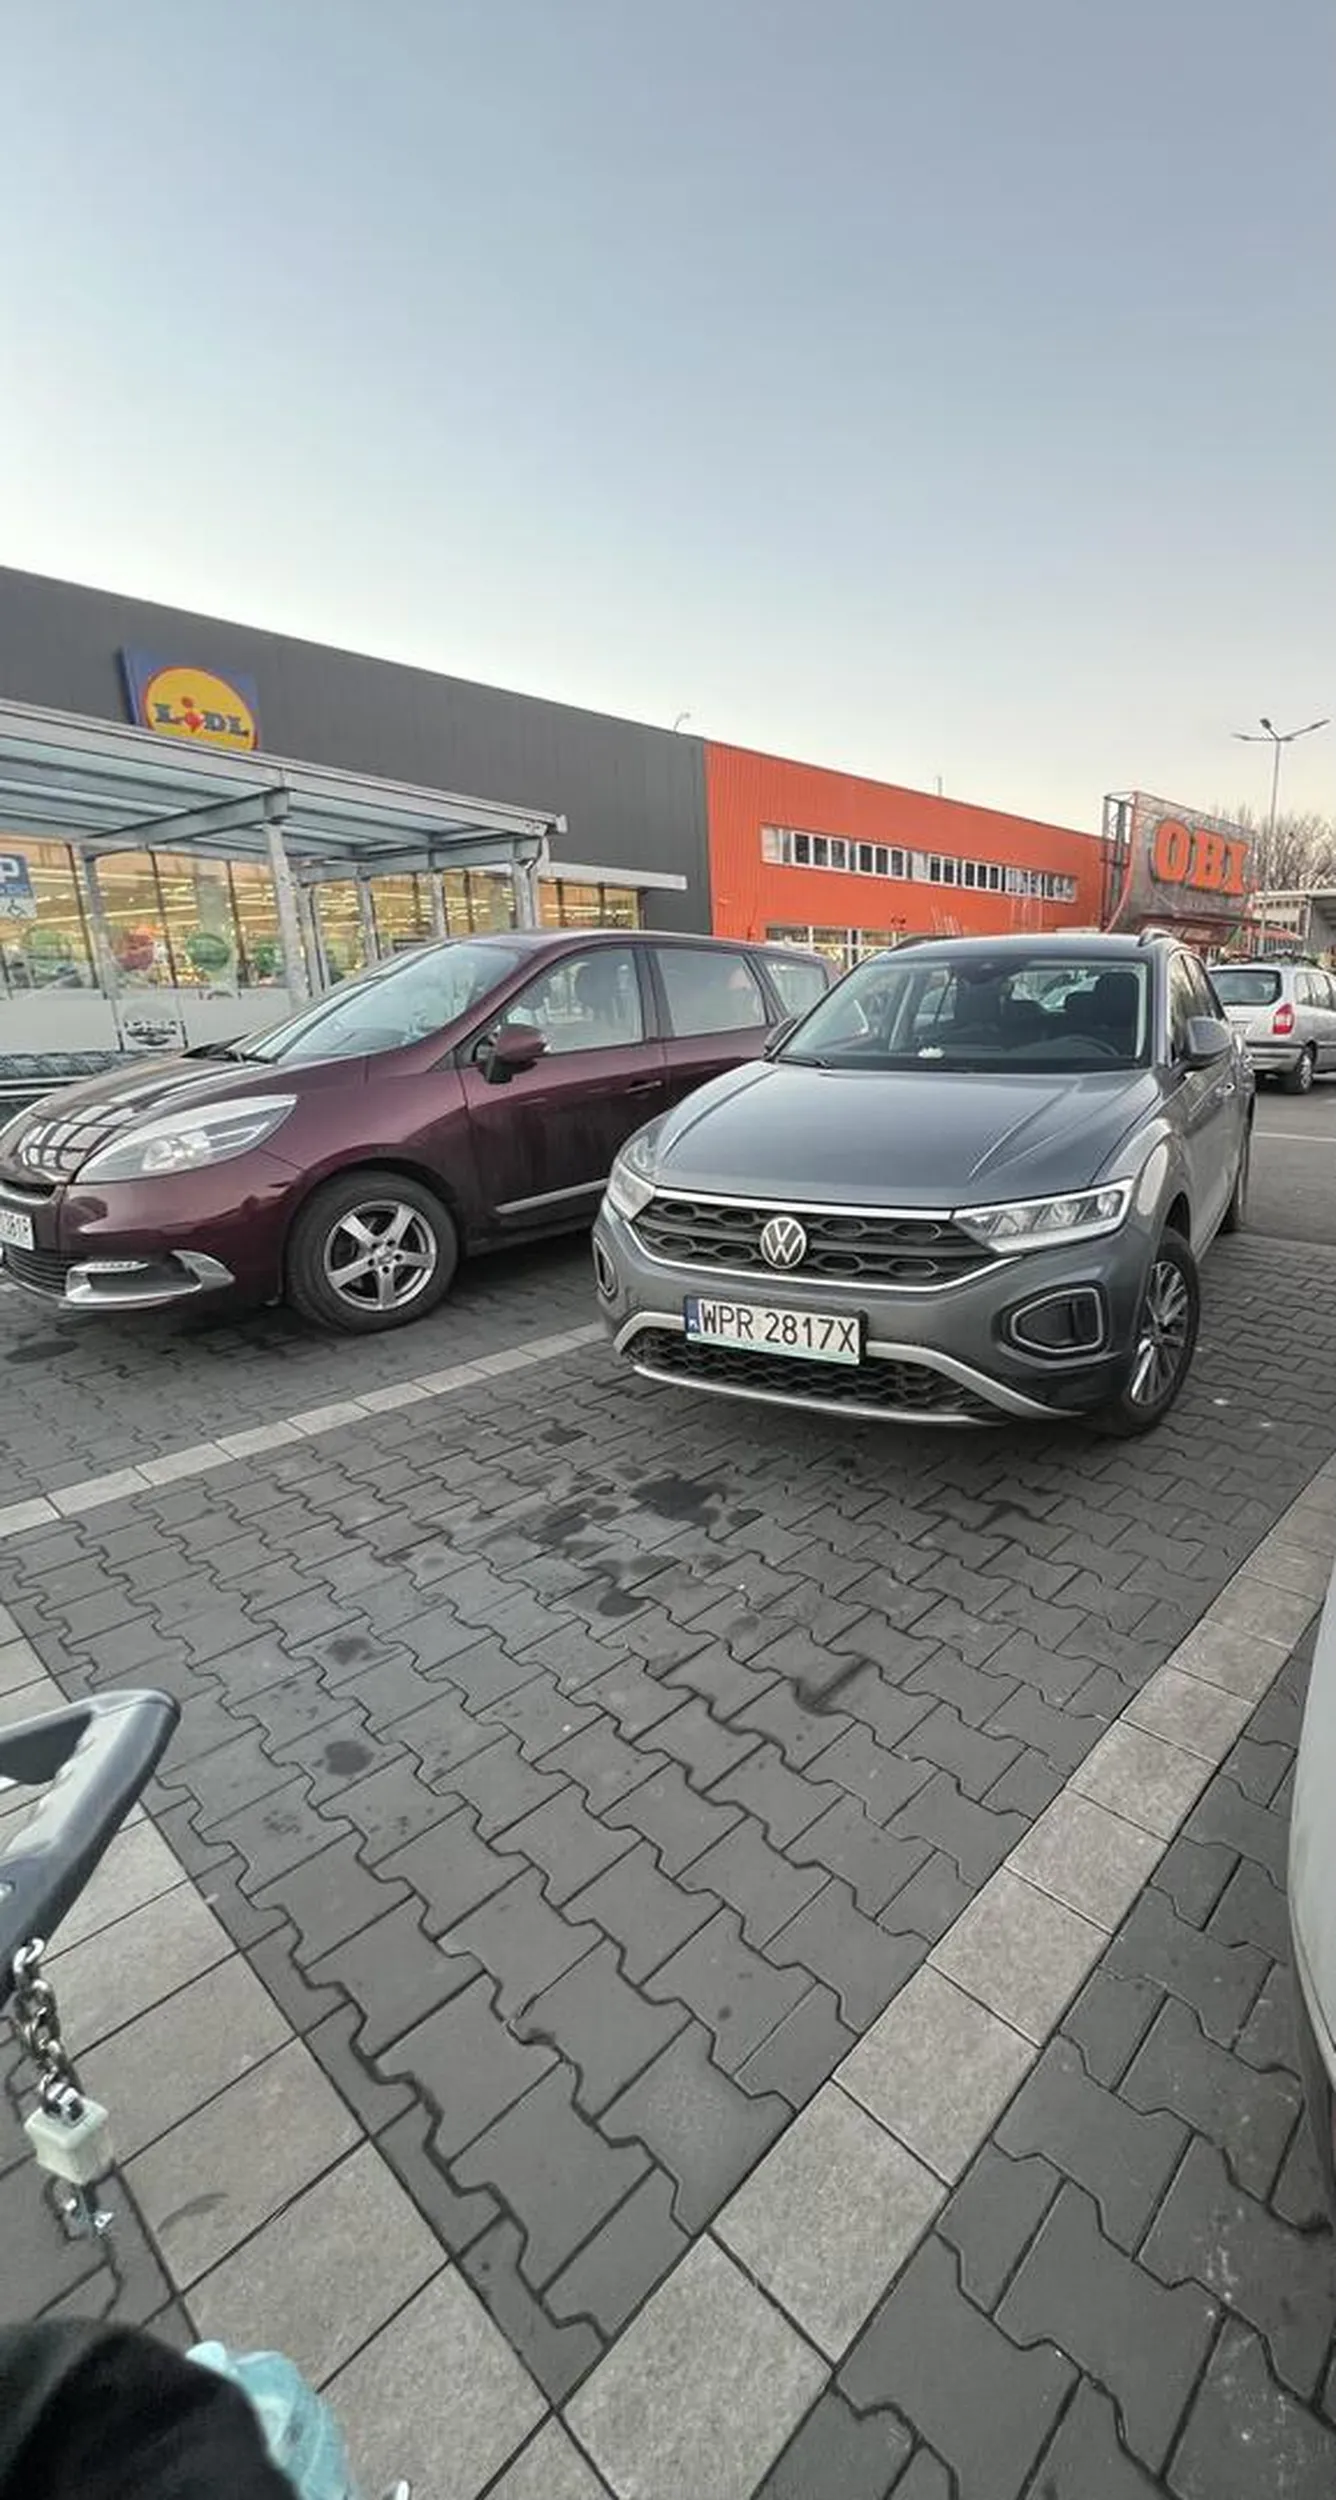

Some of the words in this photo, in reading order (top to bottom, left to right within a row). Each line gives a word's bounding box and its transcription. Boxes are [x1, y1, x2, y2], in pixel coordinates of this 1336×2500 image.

[1154, 818, 1249, 896] OBI
[701, 1302, 754, 1340] WPR
[765, 1312, 856, 1354] 2817X
